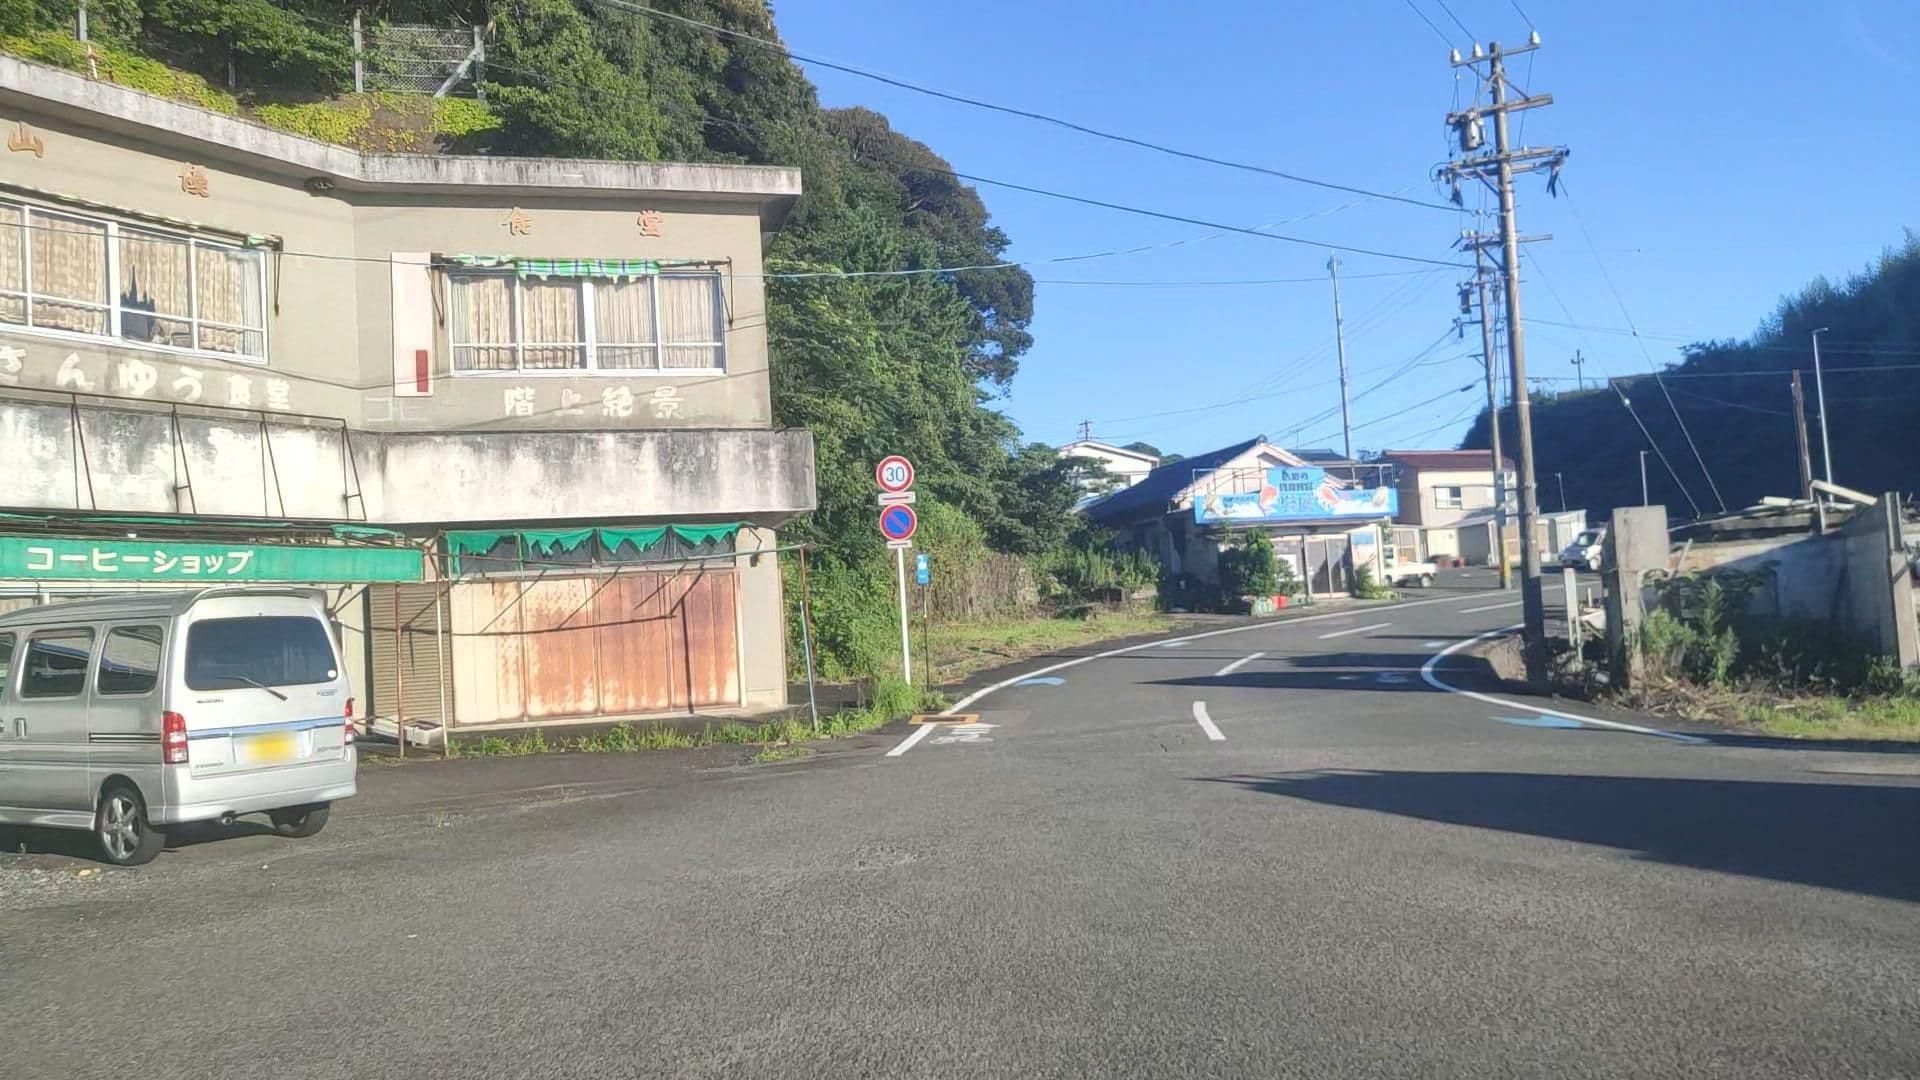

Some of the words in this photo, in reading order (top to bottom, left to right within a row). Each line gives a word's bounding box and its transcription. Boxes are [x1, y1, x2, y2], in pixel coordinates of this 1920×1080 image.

[886, 466, 905, 482] 30
[27, 547, 254, 575] コーヒーショップ
